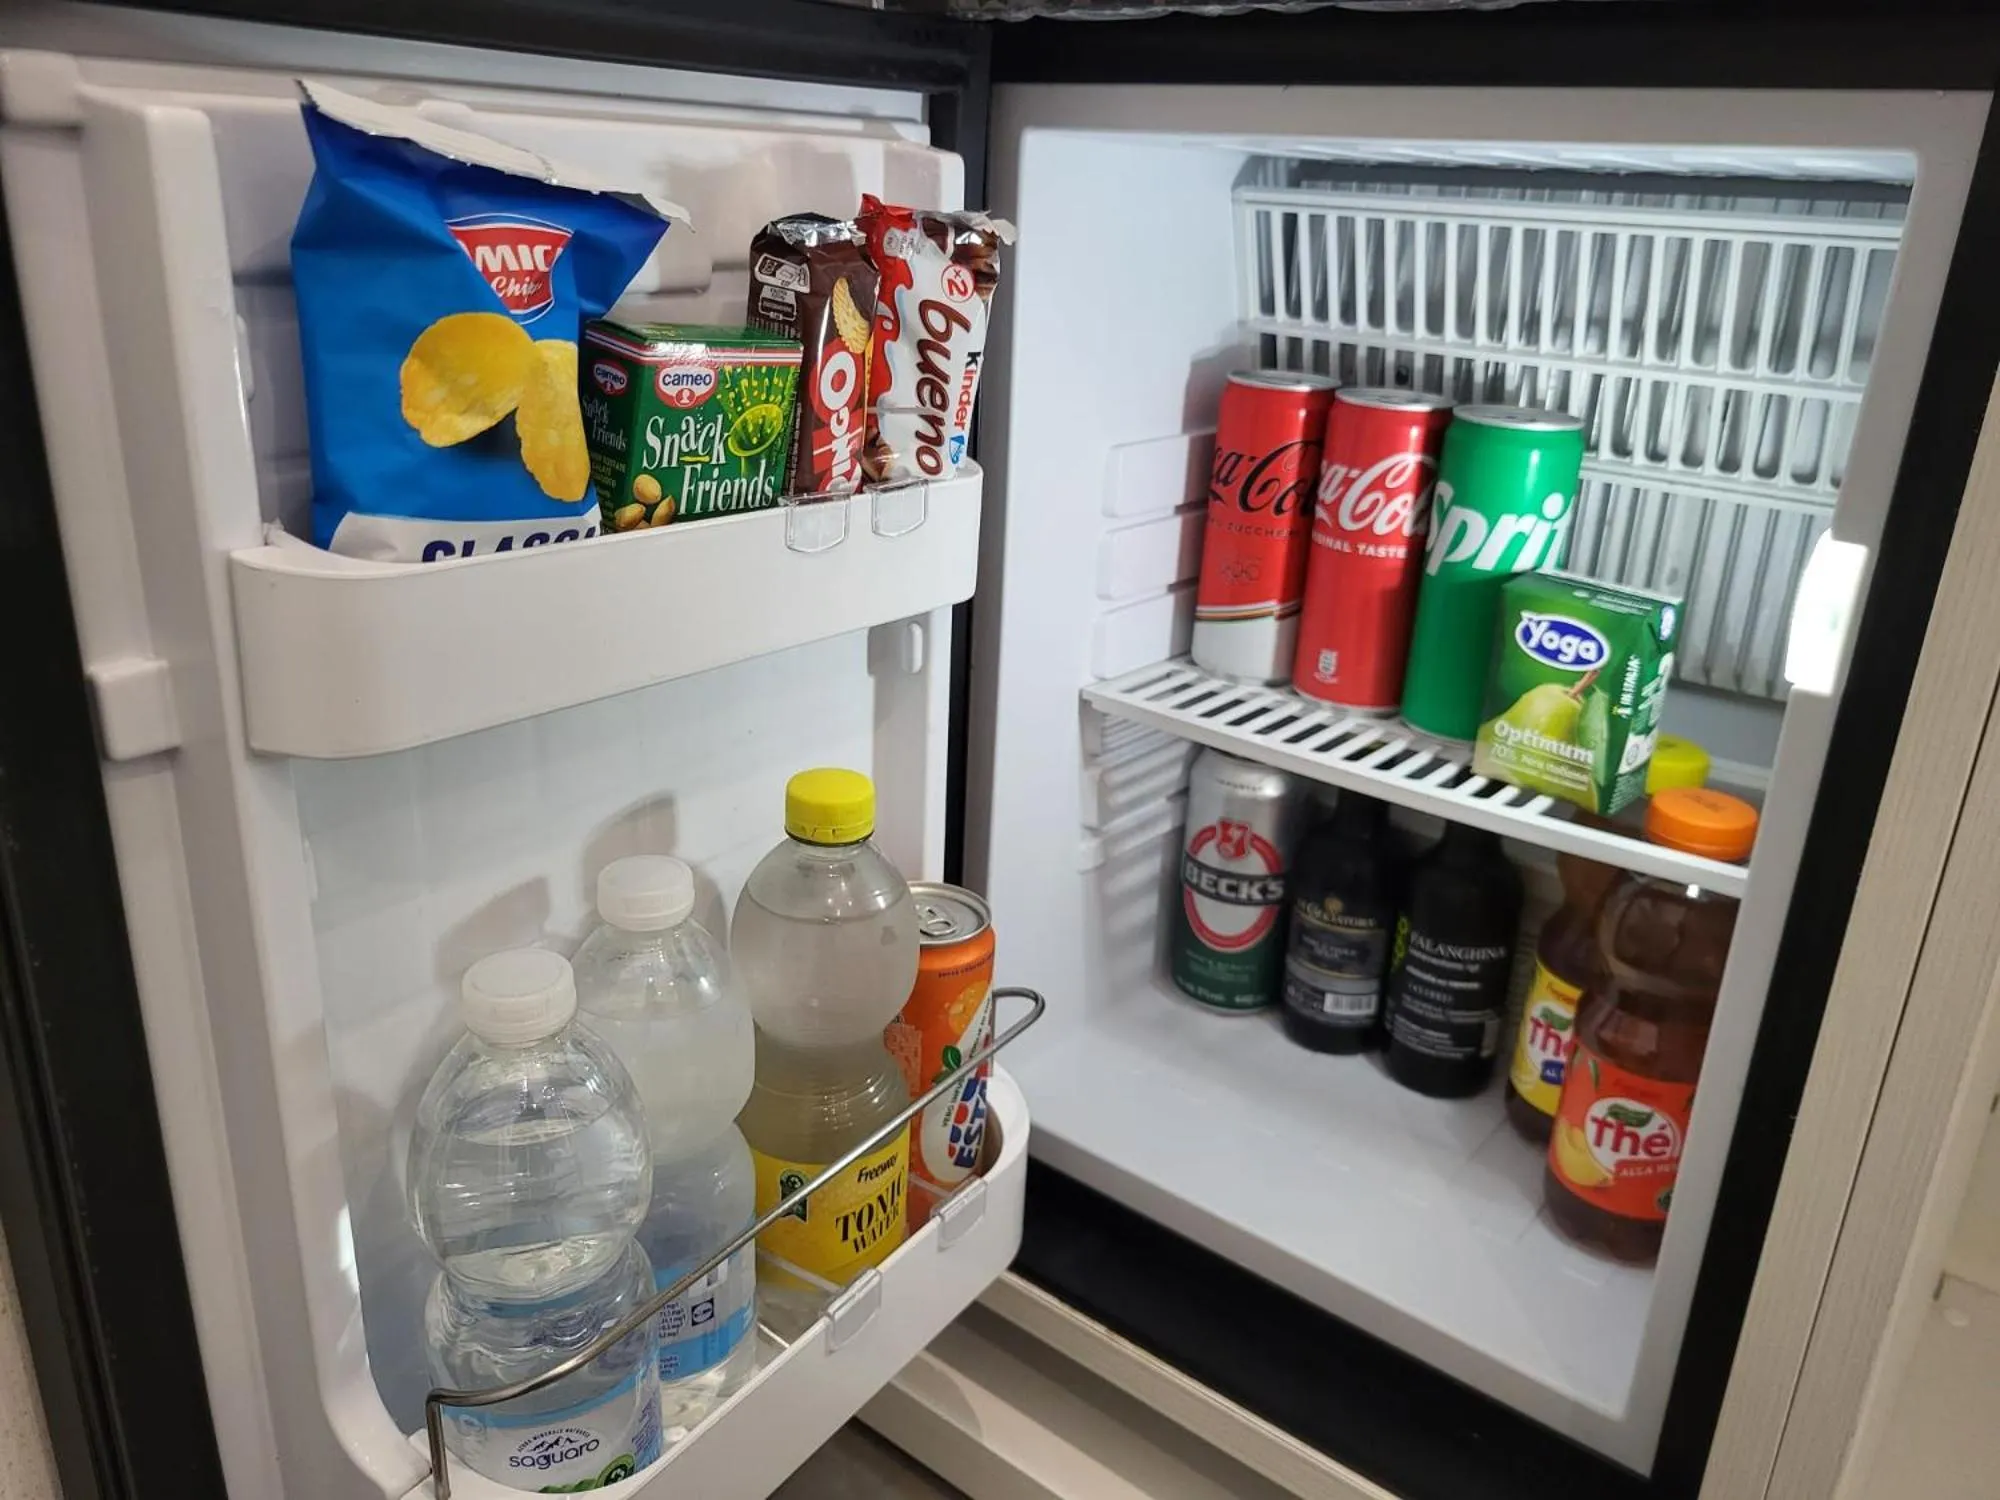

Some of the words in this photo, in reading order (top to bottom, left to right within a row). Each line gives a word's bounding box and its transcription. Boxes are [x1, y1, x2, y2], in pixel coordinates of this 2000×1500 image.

[594, 364, 626, 386] cameo
[662, 371, 712, 387] cameo
[915, 299, 972, 476] bueno
[954, 351, 982, 431] Kinder
[642, 413, 730, 469] Snack
[679, 459, 774, 515] Friends
[1357, 543, 1408, 559] TASTE
[1523, 617, 1600, 664] Yoga
[1493, 720, 1594, 765] Optimum
[1590, 1115, 1671, 1157] Thé
[509, 1438, 600, 1470] saguaro
